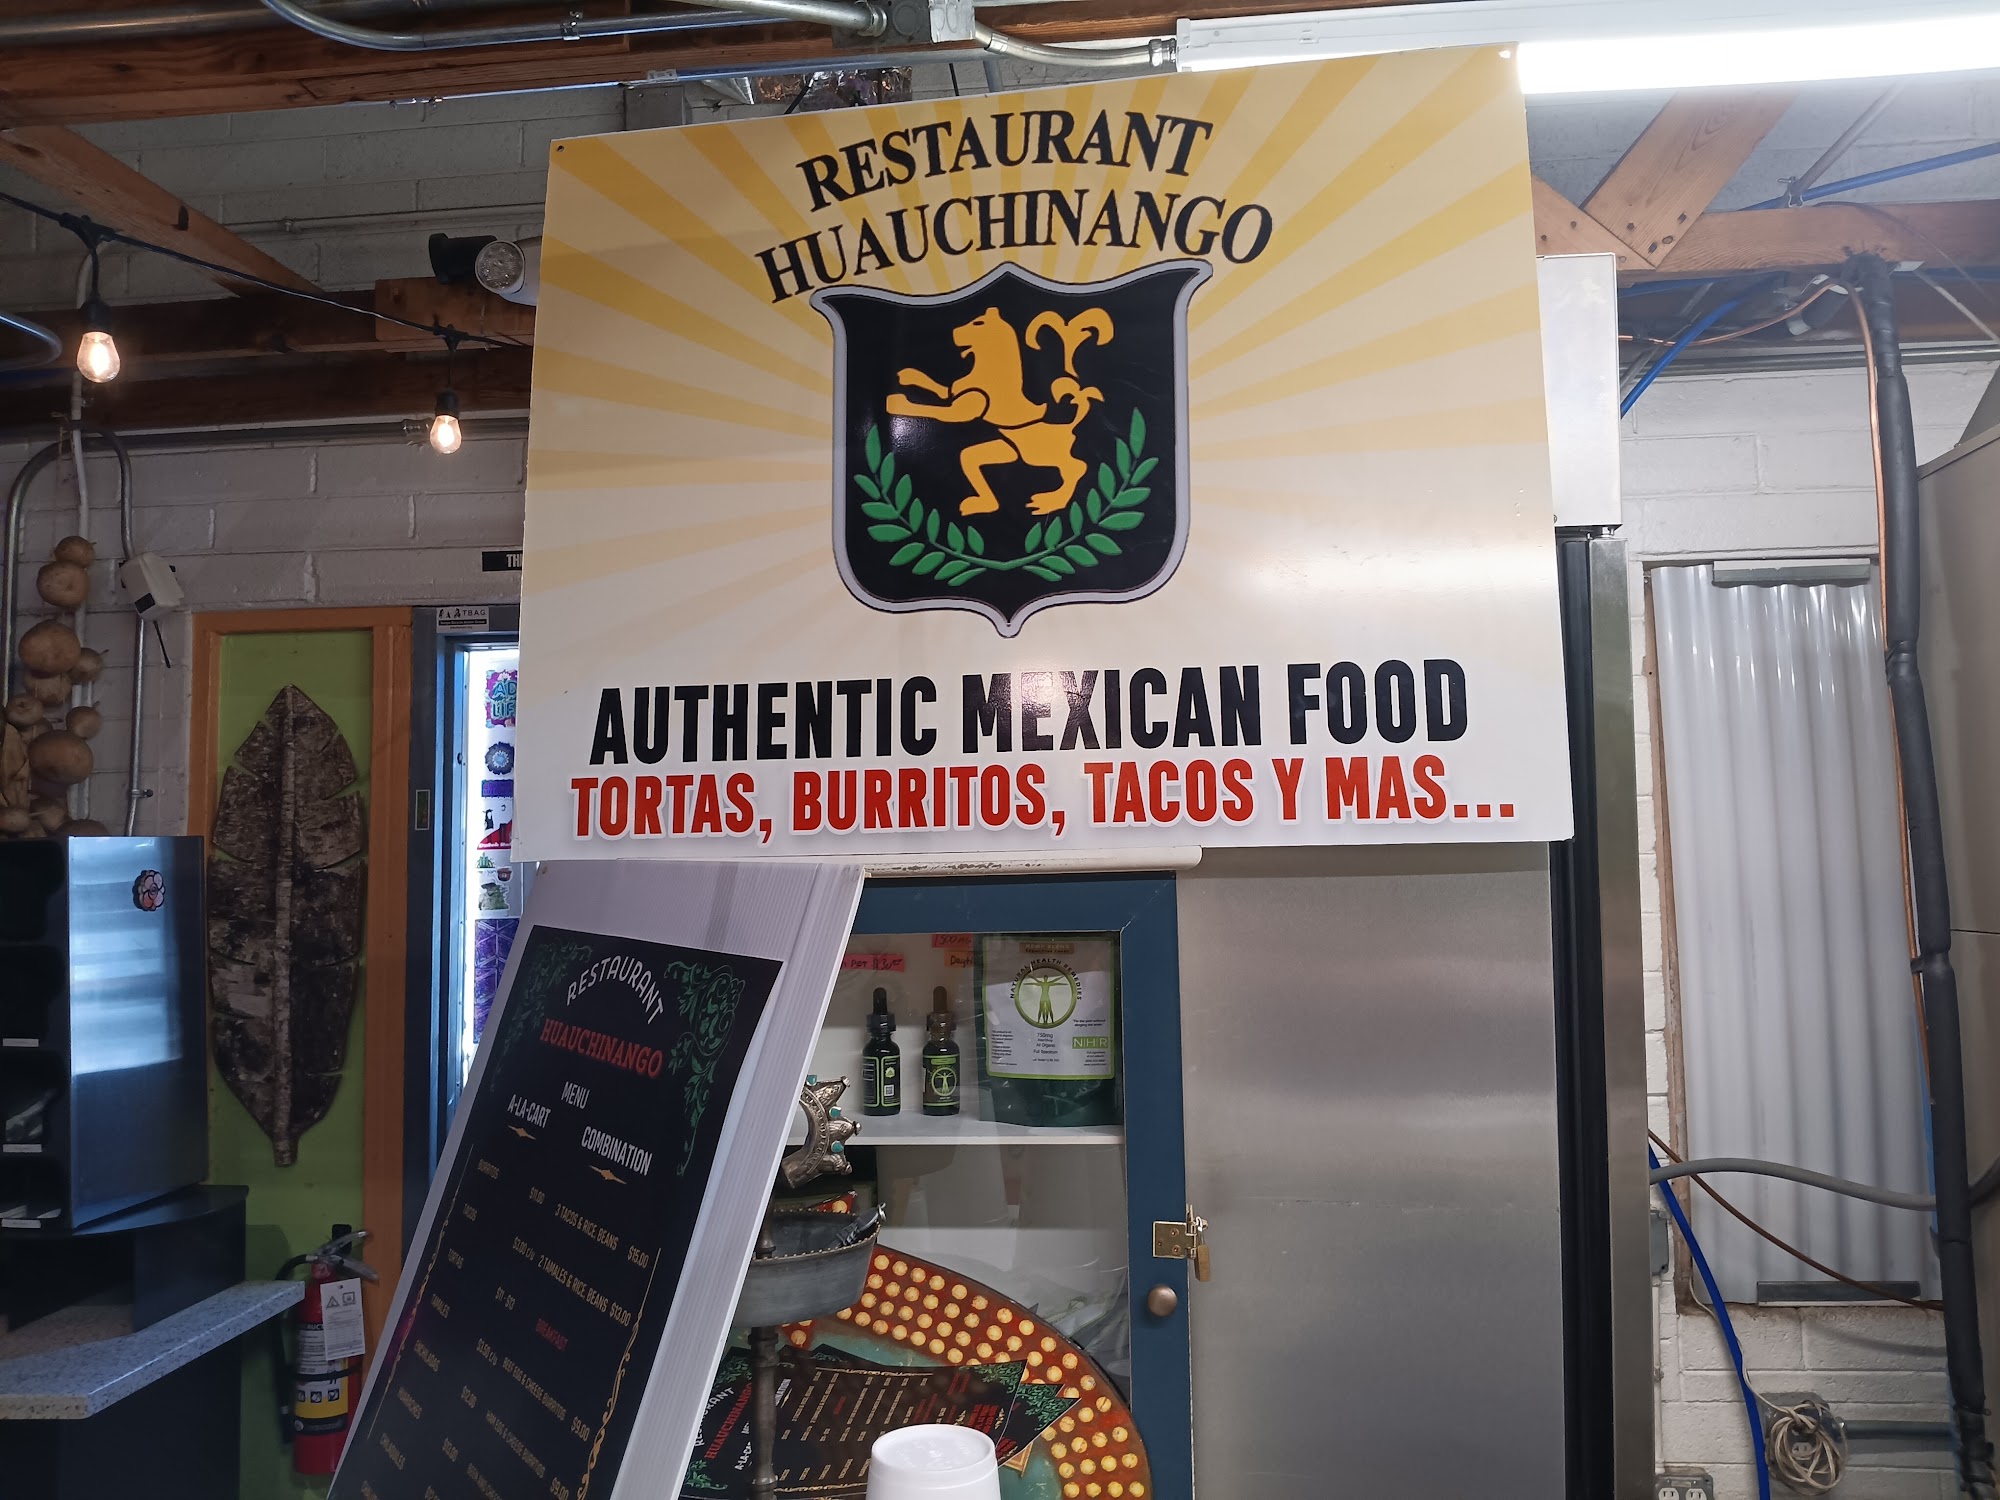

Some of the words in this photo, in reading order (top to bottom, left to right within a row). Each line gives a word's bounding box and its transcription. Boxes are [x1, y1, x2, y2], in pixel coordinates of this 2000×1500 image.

[796, 109, 1213, 211] RESTAURANT
[755, 188, 1272, 303] HUAUCHINANGO
[589, 675, 937, 765] AUTHENTIC
[962, 665, 1262, 754] MEXICAN
[1287, 659, 1468, 745] FOOD
[571, 772, 773, 844] TORTAS,
[792, 763, 1065, 838] BURRITOS,
[1084, 759, 1254, 823] TACOS
[1271, 758, 1304, 821] Y
[566, 955, 664, 1024] RESTAURANT
[1009, 964, 1031, 999] NATURAL
[1030, 958, 1062, 966] HEALTH
[1063, 963, 1082, 1000] REMEDIES
[539, 1019, 664, 1078] HUAUCHINANGO
[561, 1081, 590, 1109] MENU
[581, 1126, 652, 1176] COMBINATION
[554, 1203, 561, 1216] 3
[559, 1206, 578, 1226] TACOS
[576, 1216, 584, 1229] &
[596, 1228, 619, 1250] BEANS
[626, 1245, 650, 1269] $15.00
[537, 1254, 544, 1267] 2
[542, 1257, 567, 1284] TAMALES
[565, 1273, 573, 1288] &
[586, 1287, 609, 1313] BEANS
[609, 1302, 631, 1327] $13.00
[571, 1415, 590, 1442] $9.00
